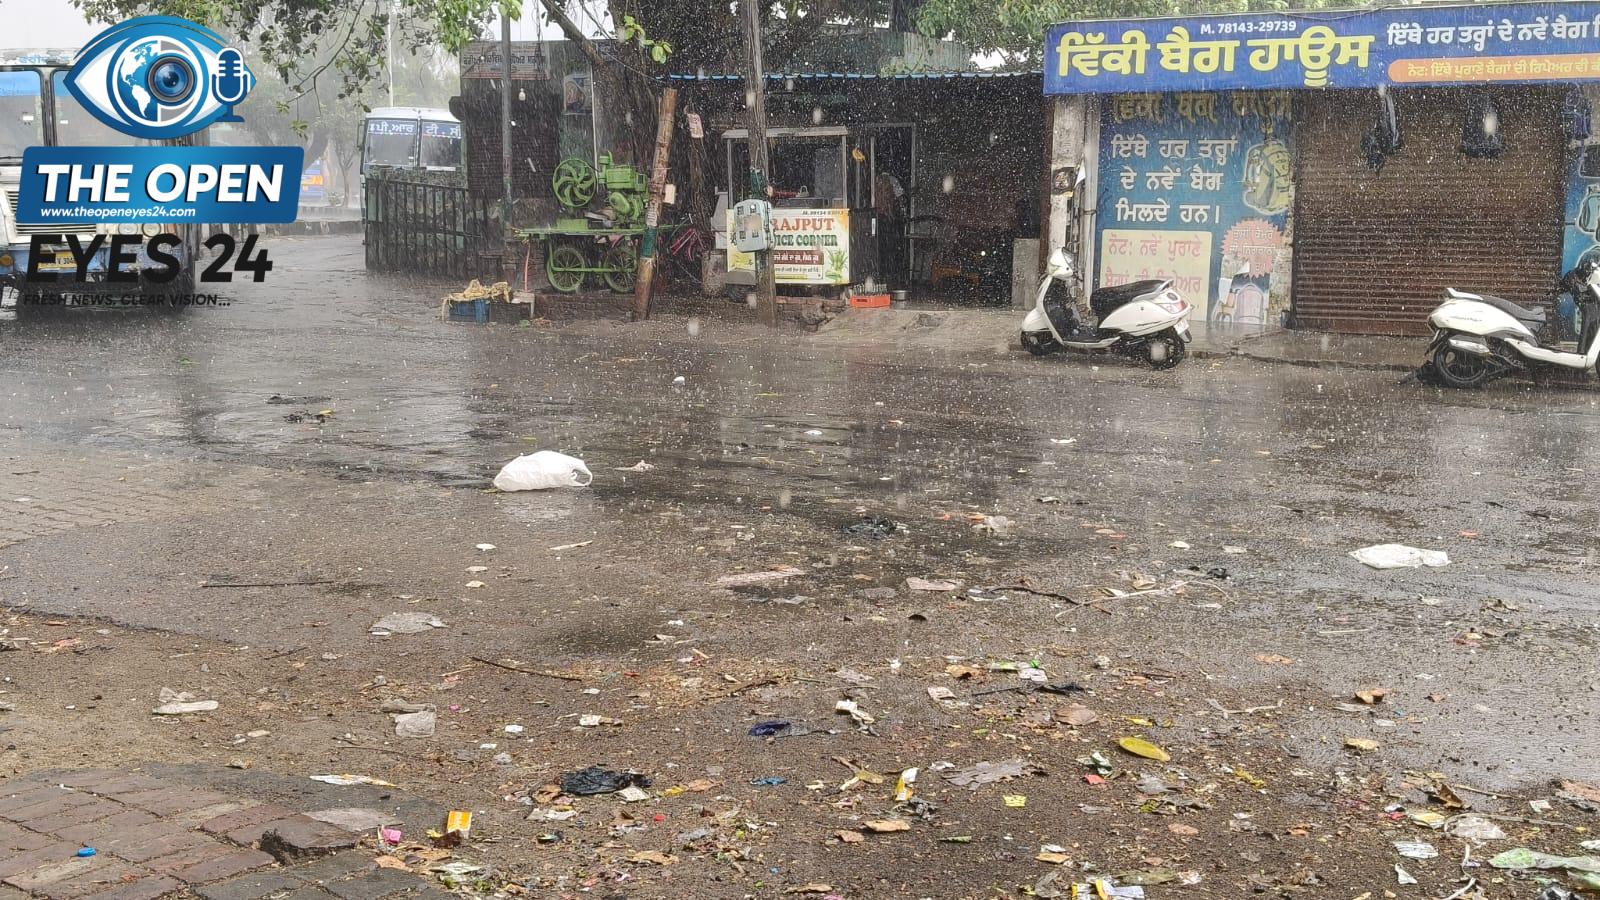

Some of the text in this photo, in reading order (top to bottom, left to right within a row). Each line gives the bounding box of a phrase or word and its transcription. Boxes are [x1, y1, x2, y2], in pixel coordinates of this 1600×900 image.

[1200, 21, 1297, 34] M. 78143-29739
[1387, 22, 1423, 45] ਇੱਥੇ
[1426, 27, 1455, 44] ਹਰ
[1498, 19, 1514, 42] ਦੇ
[1517, 16, 1548, 41] ਨਵੇਂ
[1552, 14, 1590, 40] ਬੈਗ
[1056, 25, 1375, 87] ਵਿੱਕੀ ਬੈਗ ਹਾਊਸ
[1110, 134, 1149, 159] ਇੱਥੇ
[1158, 140, 1189, 158] ਹਰ
[1120, 164, 1224, 192] ਦੇ ਨਵੇਂ ਬੈਗ
[1115, 197, 1170, 222] ਮਿਲਦੇ
[796, 234, 838, 247] CORNER
